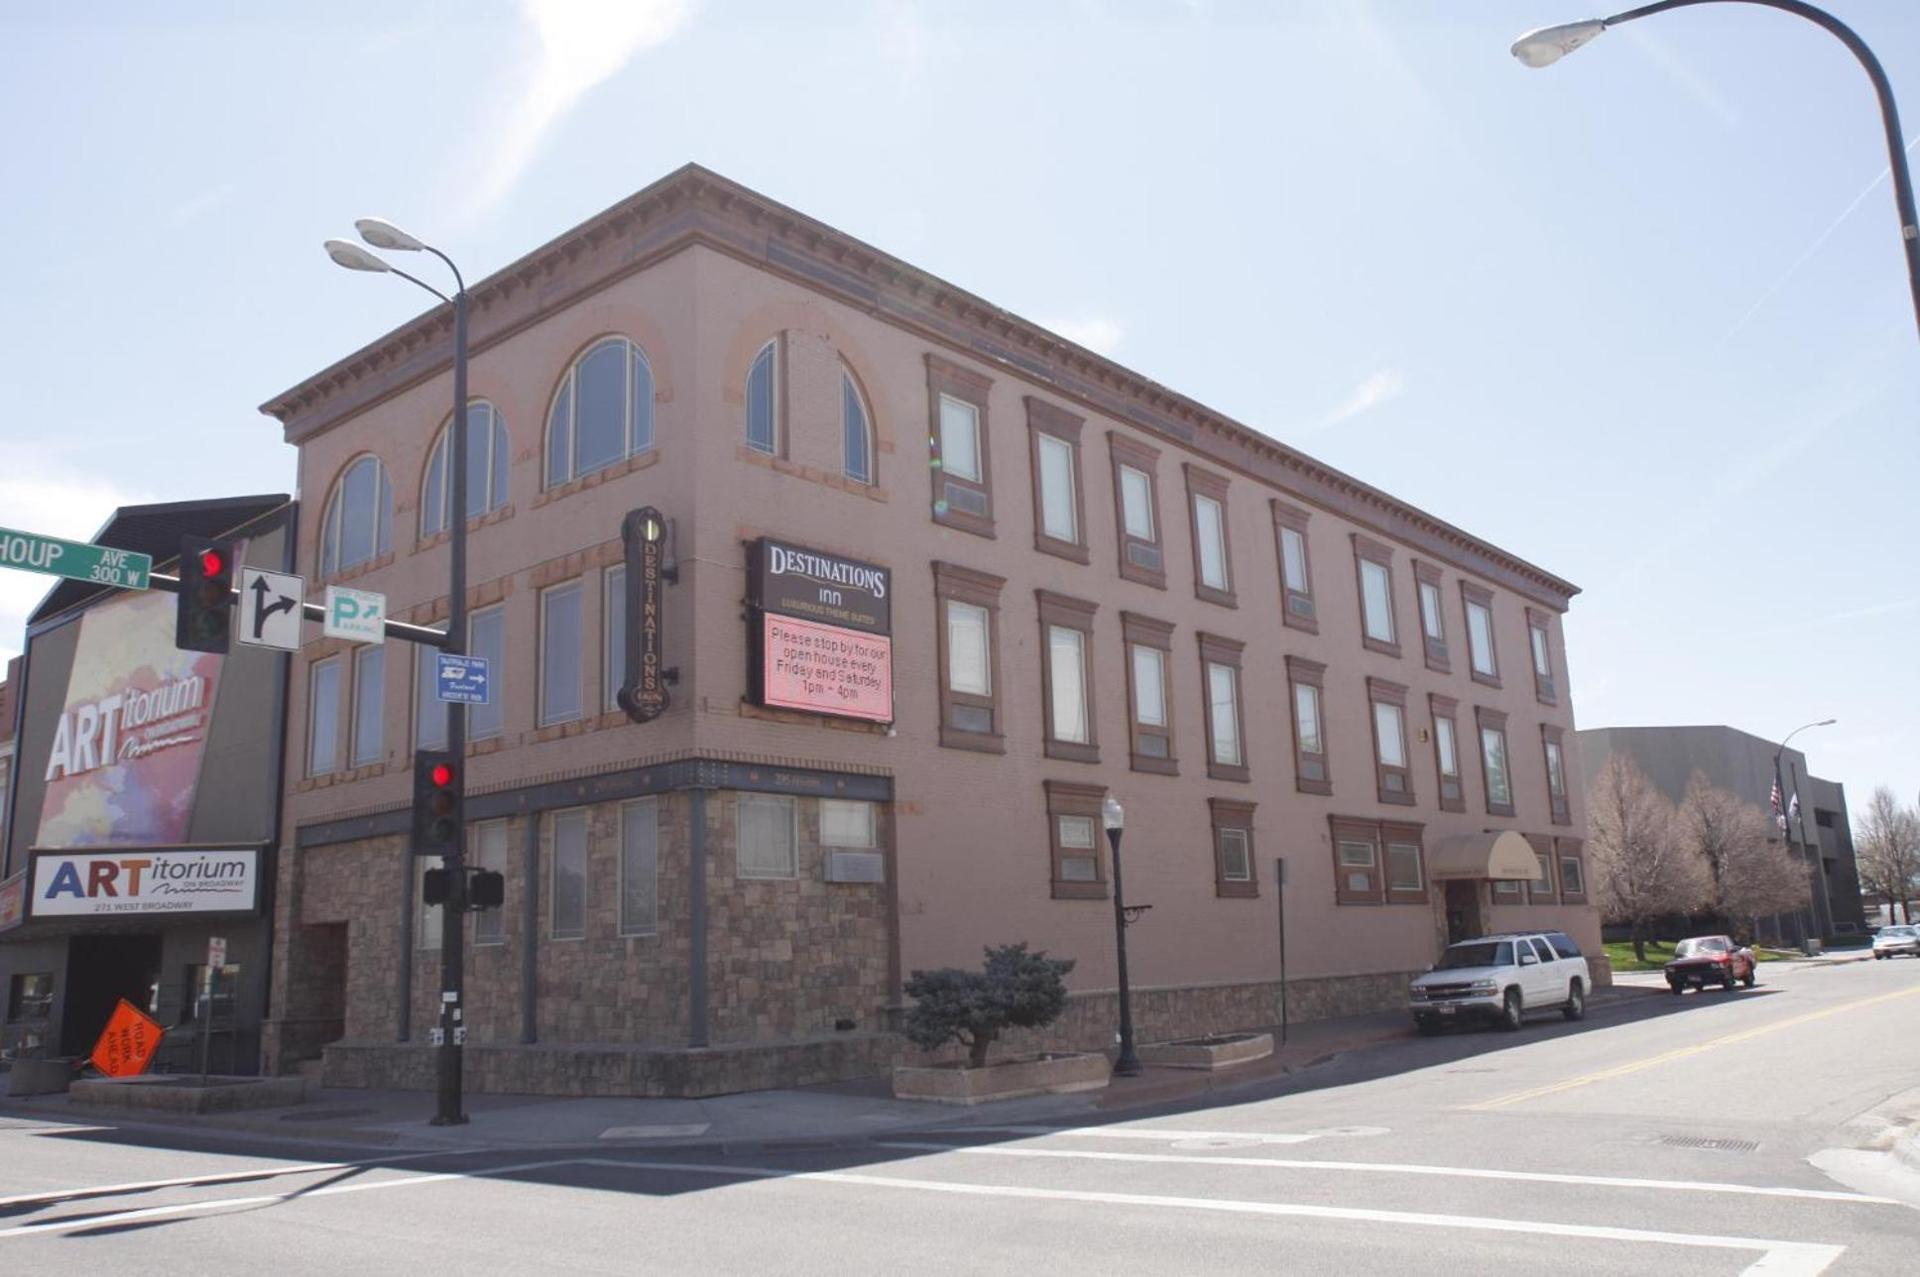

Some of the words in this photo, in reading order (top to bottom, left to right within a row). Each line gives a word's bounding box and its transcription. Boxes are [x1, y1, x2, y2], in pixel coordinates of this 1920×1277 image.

[100, 550, 128, 569] AVE
[770, 546, 885, 598] DESTINATIONS
[90, 564, 121, 583] 300
[127, 570, 140, 587] W
[643, 542, 658, 690] DESTINATIONS
[771, 626, 812, 647] Please
[814, 636, 838, 652] stop
[840, 641, 853, 657] by
[854, 643, 869, 657] for
[870, 648, 886, 660] our
[776, 659, 814, 679] Friday
[815, 666, 836, 682] and
[838, 669, 882, 690] Saturday
[783, 647, 812, 661] open
[814, 651, 849, 669] house
[850, 659, 876, 676] every
[802, 679, 824, 695] 1pm
[837, 684, 859, 699] 4pm
[45, 856, 245, 899] ARTitorium
[184, 880, 196, 888] ON
[198, 879, 245, 888] BROADWAY
[94, 902, 111, 913] 271
[113, 901, 140, 912] WEST
[141, 901, 194, 911] BROADWAY
[134, 1021, 146, 1059] ROAD
